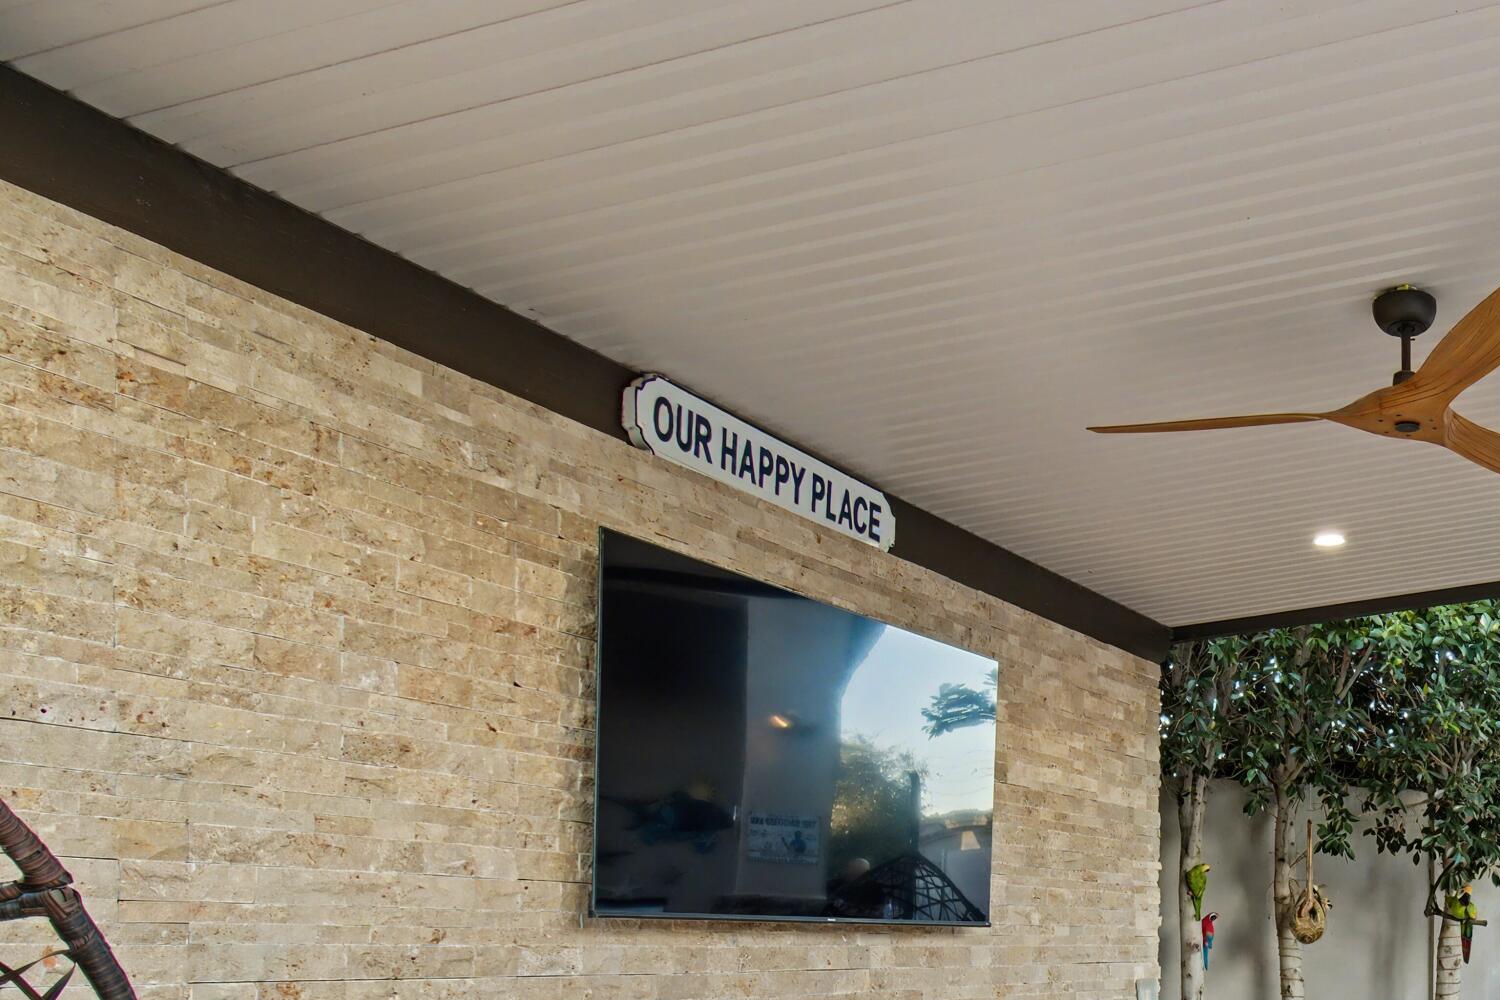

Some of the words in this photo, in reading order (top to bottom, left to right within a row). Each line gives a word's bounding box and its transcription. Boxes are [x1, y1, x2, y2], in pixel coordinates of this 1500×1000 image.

[653, 396, 713, 465] OUR
[720, 427, 806, 505] HAPPY
[811, 472, 882, 542] PLACE
